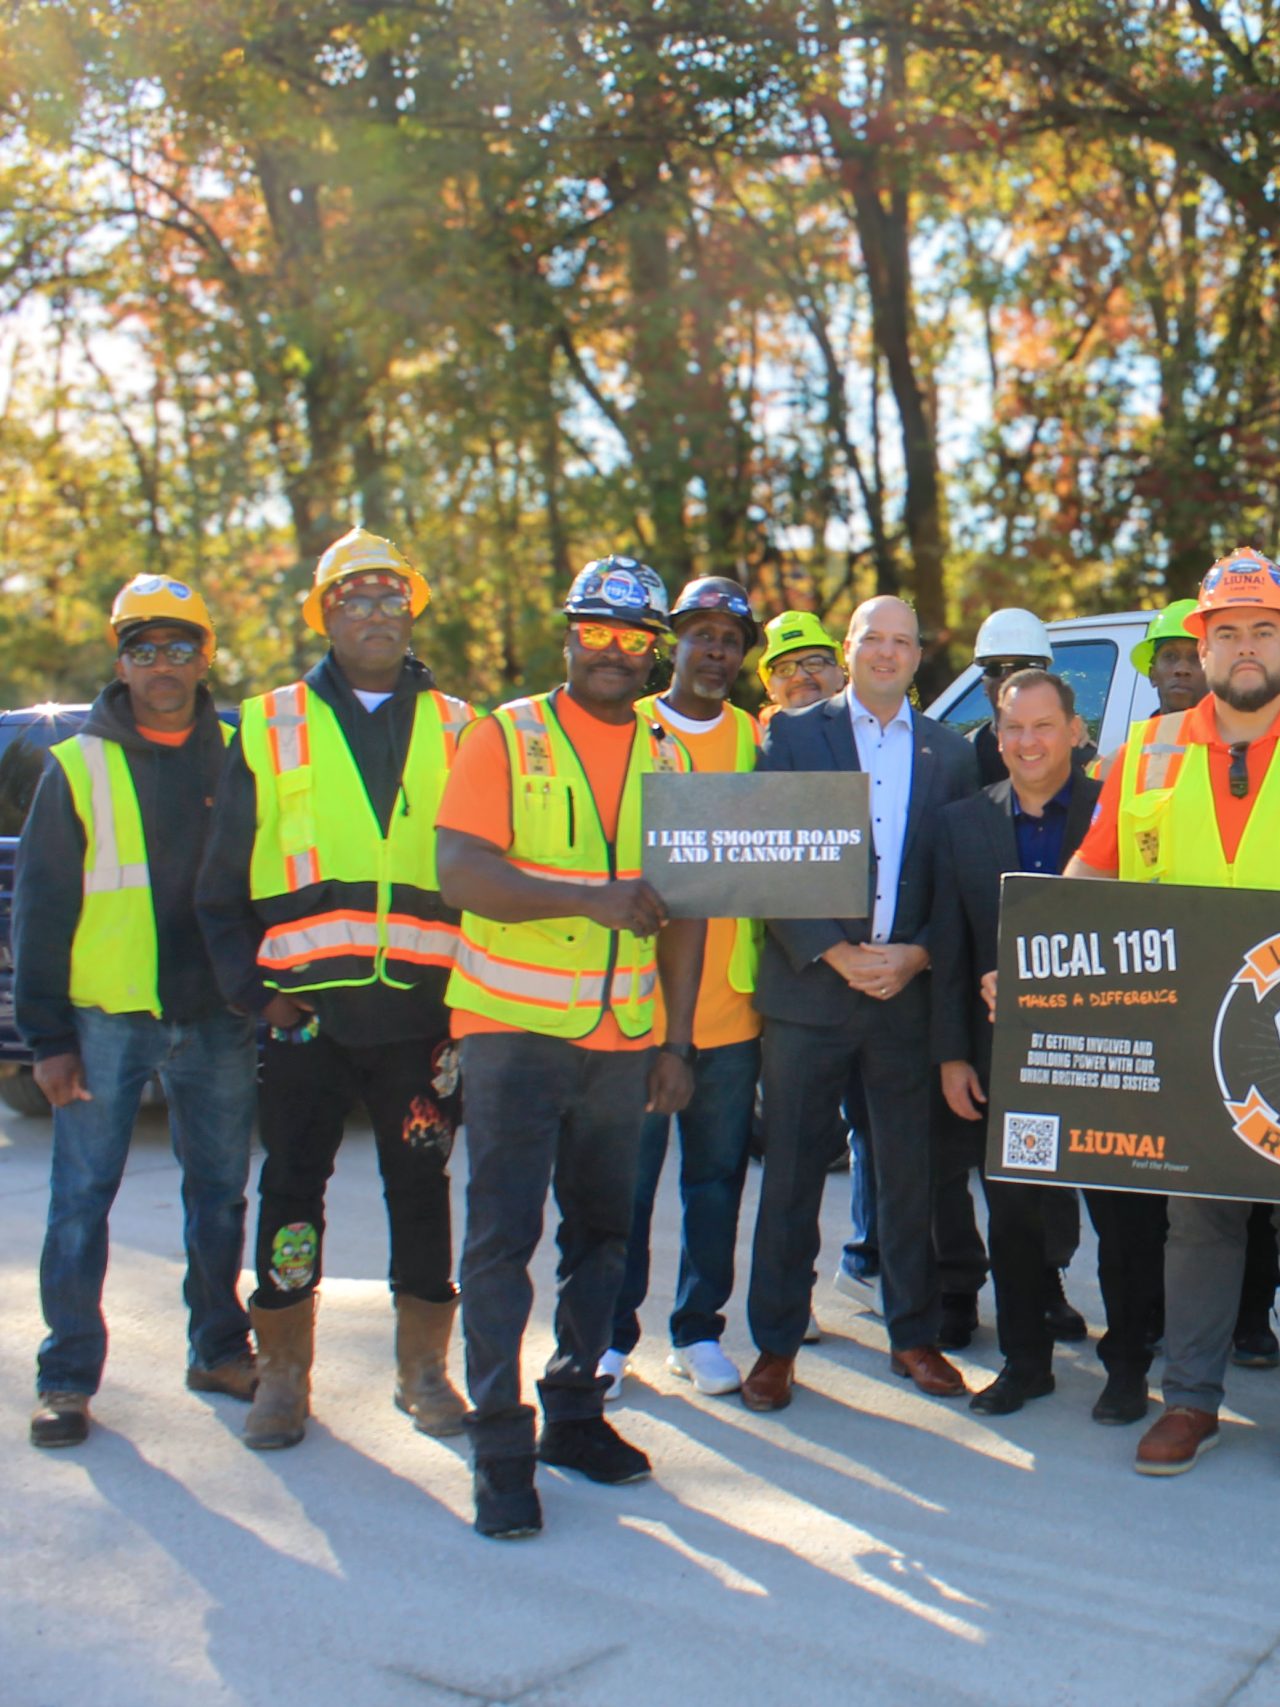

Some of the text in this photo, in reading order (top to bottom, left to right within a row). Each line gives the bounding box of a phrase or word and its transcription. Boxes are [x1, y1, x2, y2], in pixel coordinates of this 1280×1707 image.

[647, 829, 861, 846] I LIKE SMOOTH ROADS
[669, 847, 841, 862] AND I CANNOT LIE
[1016, 928, 1177, 979] LOCAL 1191
[1018, 989, 1178, 1009] MAKES A DIFFERENCE
[1031, 1032, 1153, 1057] BY GETTING INVOLVED AND
[1027, 1050, 1155, 1074] BUILDING POWER WITH OUR
[1051, 1069, 1099, 1087] BROTHERS
[1100, 1073, 1121, 1090] AND
[1122, 1074, 1161, 1092] SISTERS
